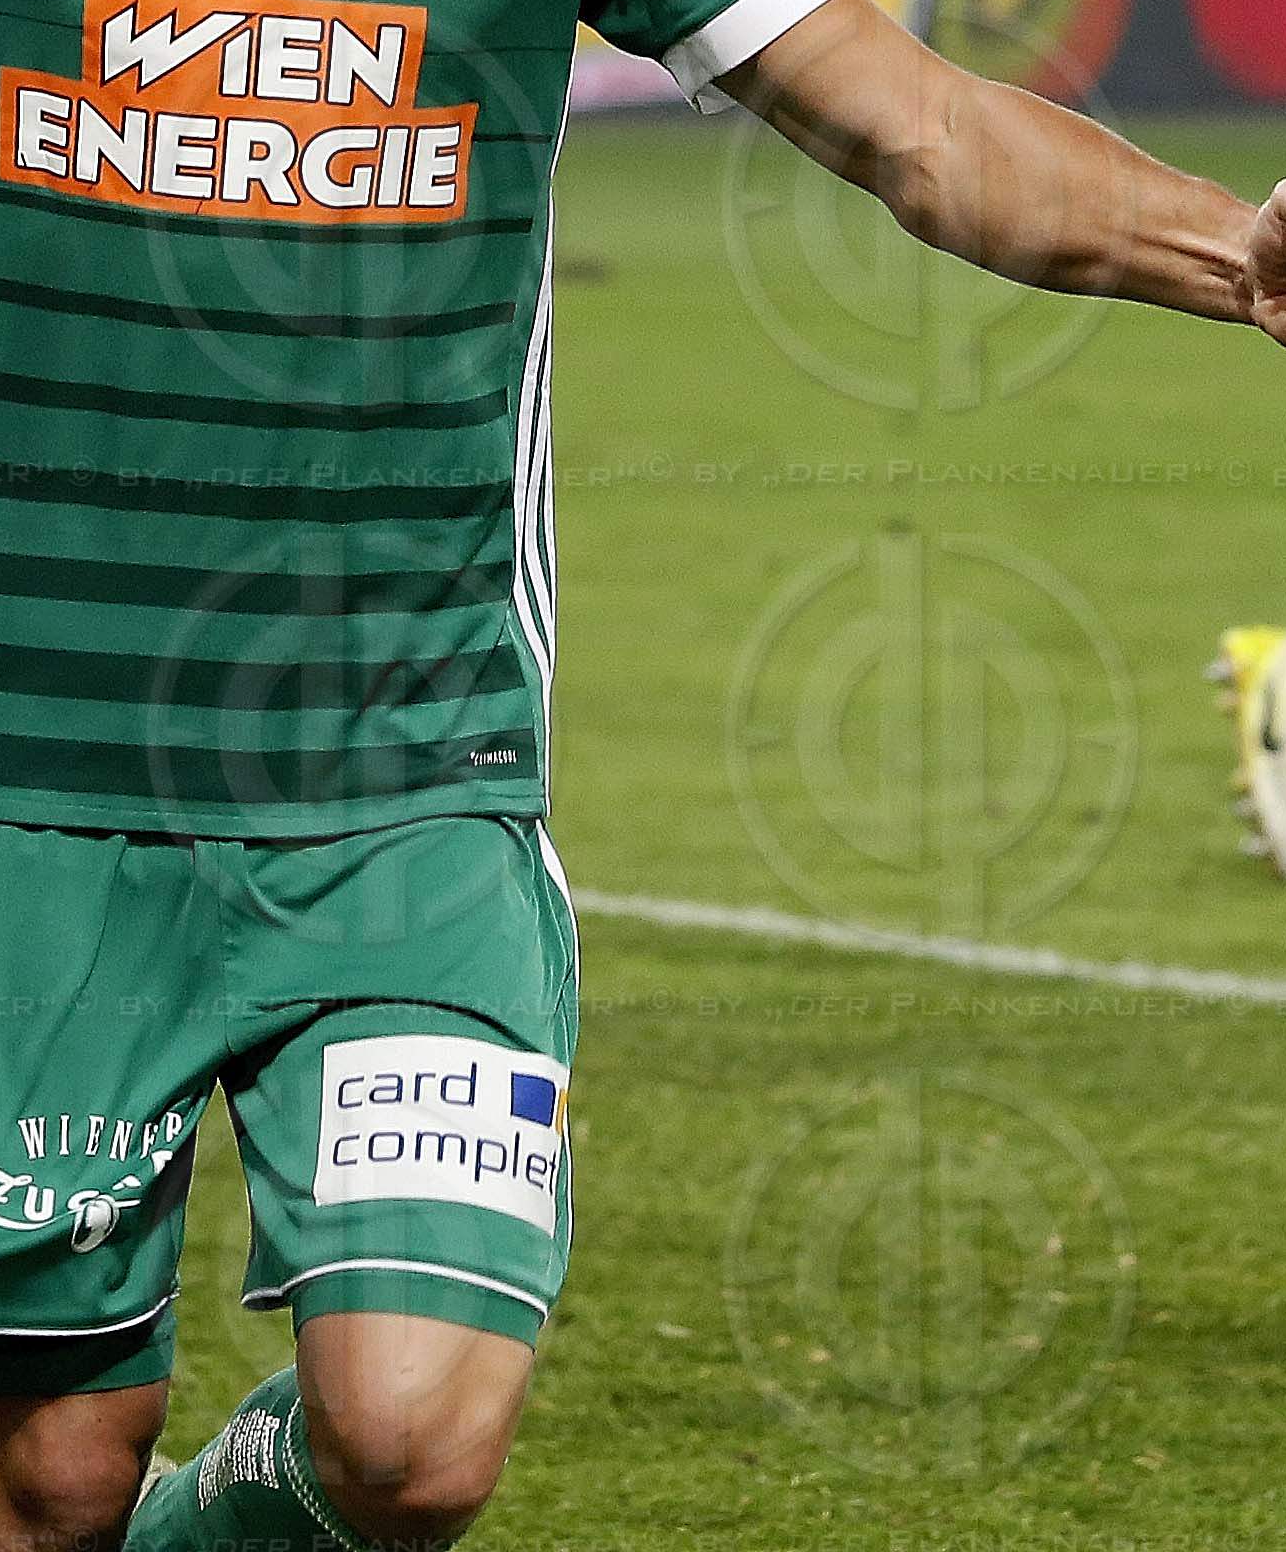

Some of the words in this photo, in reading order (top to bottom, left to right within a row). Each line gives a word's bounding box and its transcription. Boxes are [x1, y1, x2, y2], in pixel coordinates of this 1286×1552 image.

[101, 0, 408, 109] WIEN
[16, 87, 462, 209] ENERGIE
[337, 1062, 478, 1109] card
